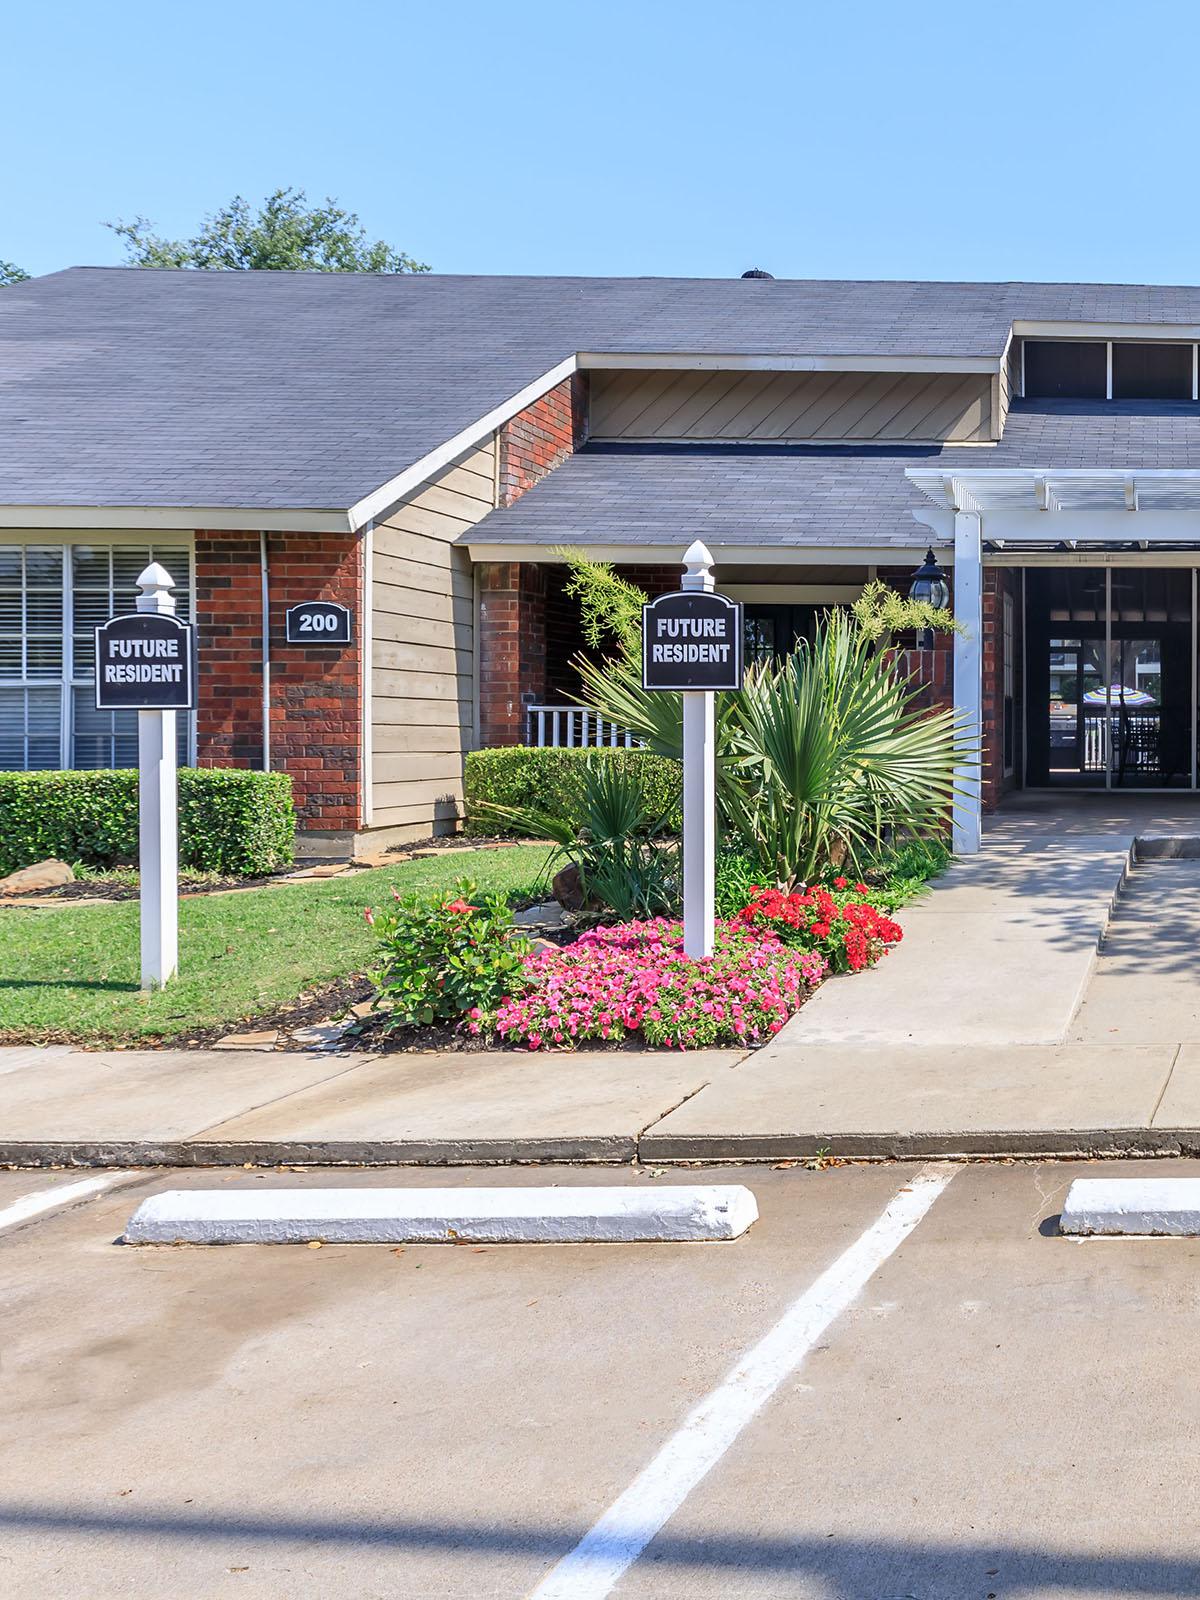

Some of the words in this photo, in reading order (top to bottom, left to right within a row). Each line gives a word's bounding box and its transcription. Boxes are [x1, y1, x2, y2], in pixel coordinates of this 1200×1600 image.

[299, 614, 338, 631] 200
[657, 618, 726, 637] FUTURE
[109, 639, 179, 658] FUTURE
[652, 644, 730, 662] RESIDENT
[105, 664, 183, 683] RESIDENT
